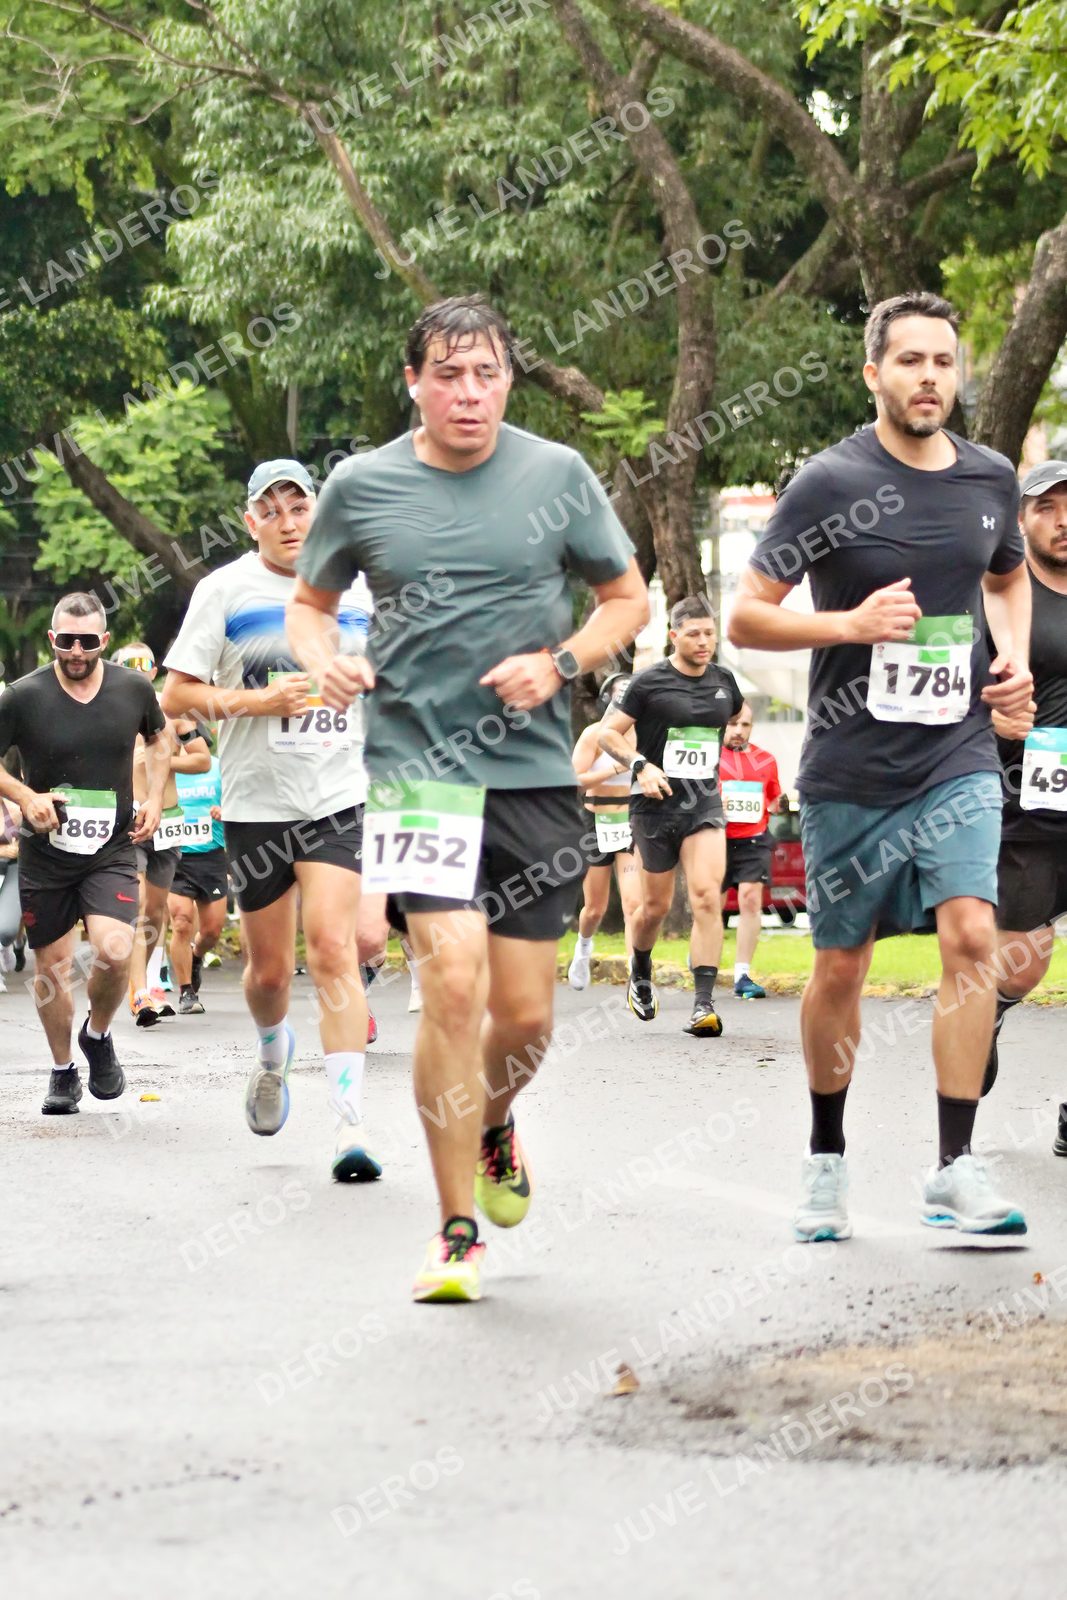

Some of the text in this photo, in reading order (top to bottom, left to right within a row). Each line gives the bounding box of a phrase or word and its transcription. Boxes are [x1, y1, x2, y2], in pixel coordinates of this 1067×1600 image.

[883, 662, 965, 698] 1784
[281, 709, 347, 733] 1786
[675, 750, 707, 766] 701
[1029, 767, 1067, 793] 49
[374, 832, 468, 869] 1752
